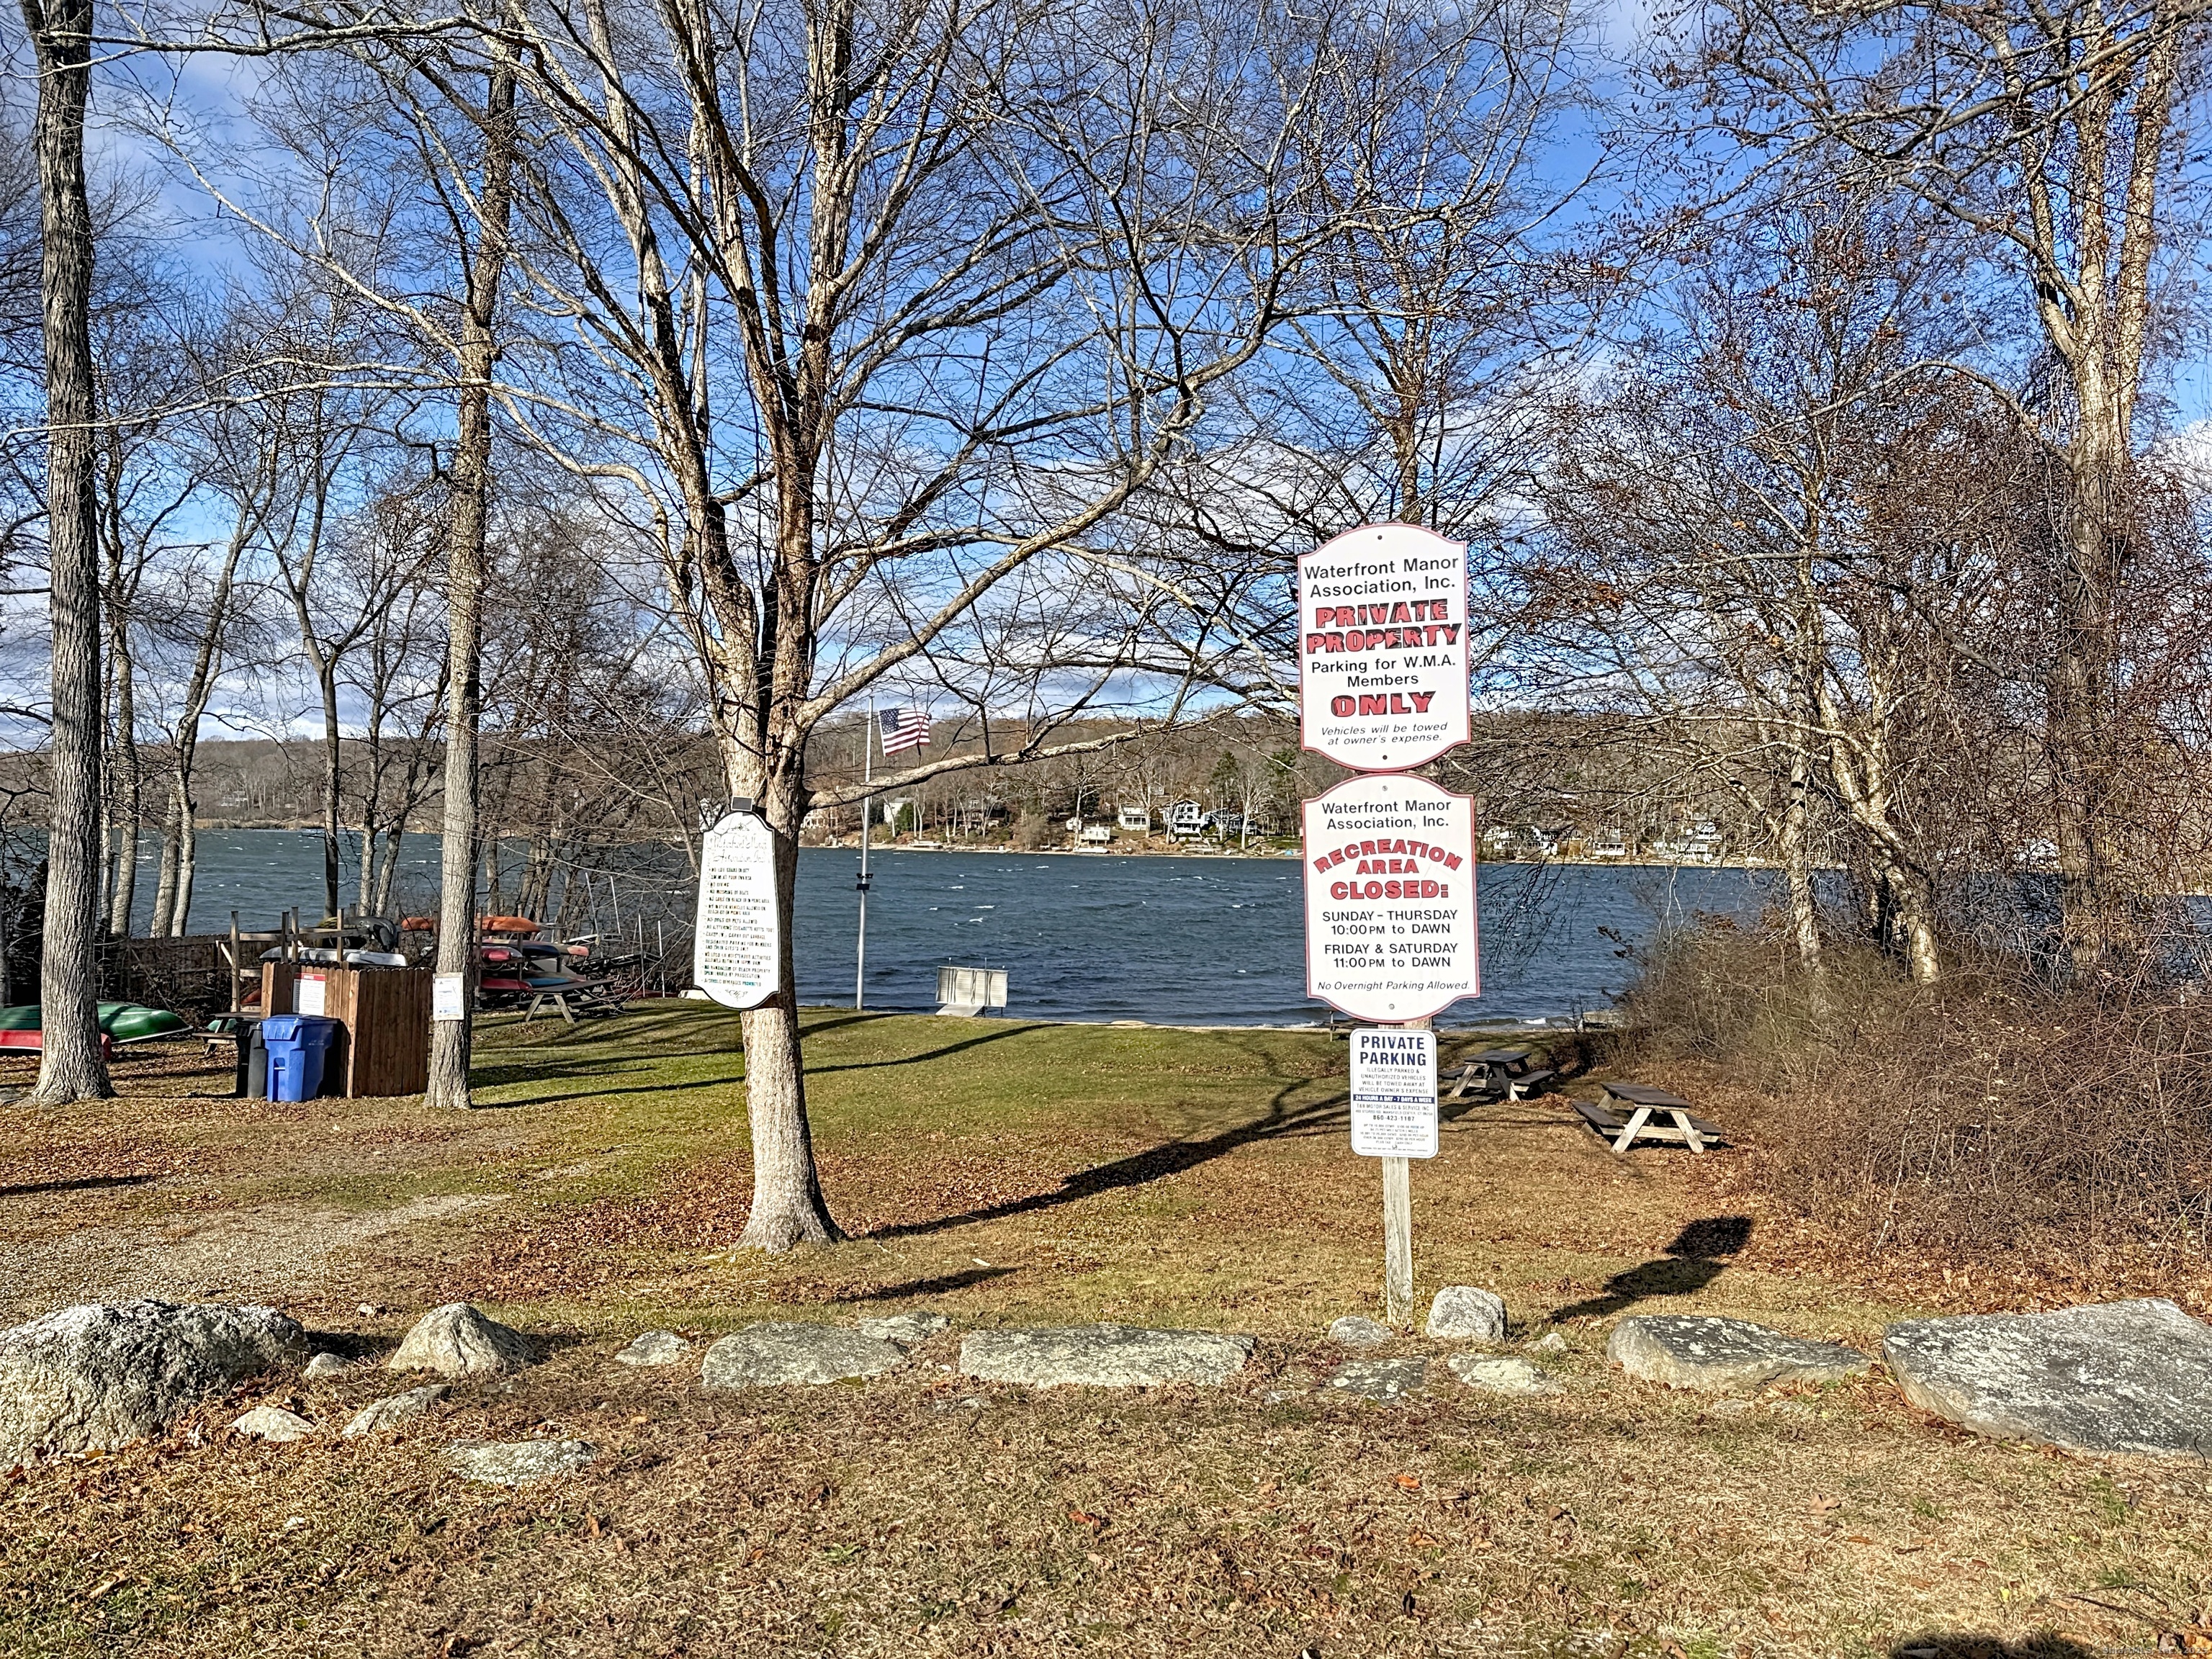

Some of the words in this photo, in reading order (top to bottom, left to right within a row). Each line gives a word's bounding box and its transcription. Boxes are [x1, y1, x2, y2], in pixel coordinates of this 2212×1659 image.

[1305, 562, 1395, 579] Waterfront
[1403, 558, 1459, 572] Manor
[1310, 580, 1416, 598] Association,
[1424, 575, 1455, 589] Inc.
[1316, 599, 1448, 628] PRIVATE
[1306, 623, 1462, 654] PROPERTY
[1312, 660, 1367, 673] Parking
[1376, 660, 1396, 670] for
[1404, 655, 1456, 667] W.M.A.
[1347, 675, 1419, 688] Members
[1331, 691, 1436, 717] ONLY
[1322, 727, 1365, 735] Vehicles
[1394, 724, 1407, 732] be
[1413, 721, 1447, 731] towed
[1328, 737, 1340, 745] at
[1344, 735, 1386, 744] owner's
[1392, 734, 1442, 744] expense.
[1322, 802, 1398, 814] Waterfront
[1406, 801, 1452, 811] Manor
[1327, 818, 1416, 830] Association,
[1424, 815, 1449, 827] Inc.
[1313, 840, 1462, 873] RECREATION
[1356, 859, 1419, 874] AREA
[1331, 881, 1449, 899] CLOSED:
[1323, 912, 1374, 921] SUNDAY
[1387, 910, 1457, 920] THURSDAY
[1331, 925, 1367, 935] 10:00
[1392, 925, 1405, 934] to
[1412, 924, 1450, 934] DAWN
[1325, 945, 1369, 954] FRIDAY
[1375, 945, 1383, 953] &
[1390, 943, 1458, 953] SATURDAY
[1334, 958, 1366, 967] 11:00
[1392, 958, 1404, 967] to
[1413, 957, 1450, 967] DAWN
[1318, 981, 1331, 990] No
[1334, 981, 1382, 991] Overnight
[1387, 981, 1424, 991] Parking
[1426, 981, 1470, 990] Allowed.
[1362, 1036, 1424, 1049] PRIVATE
[1360, 1052, 1426, 1066] PARKING
